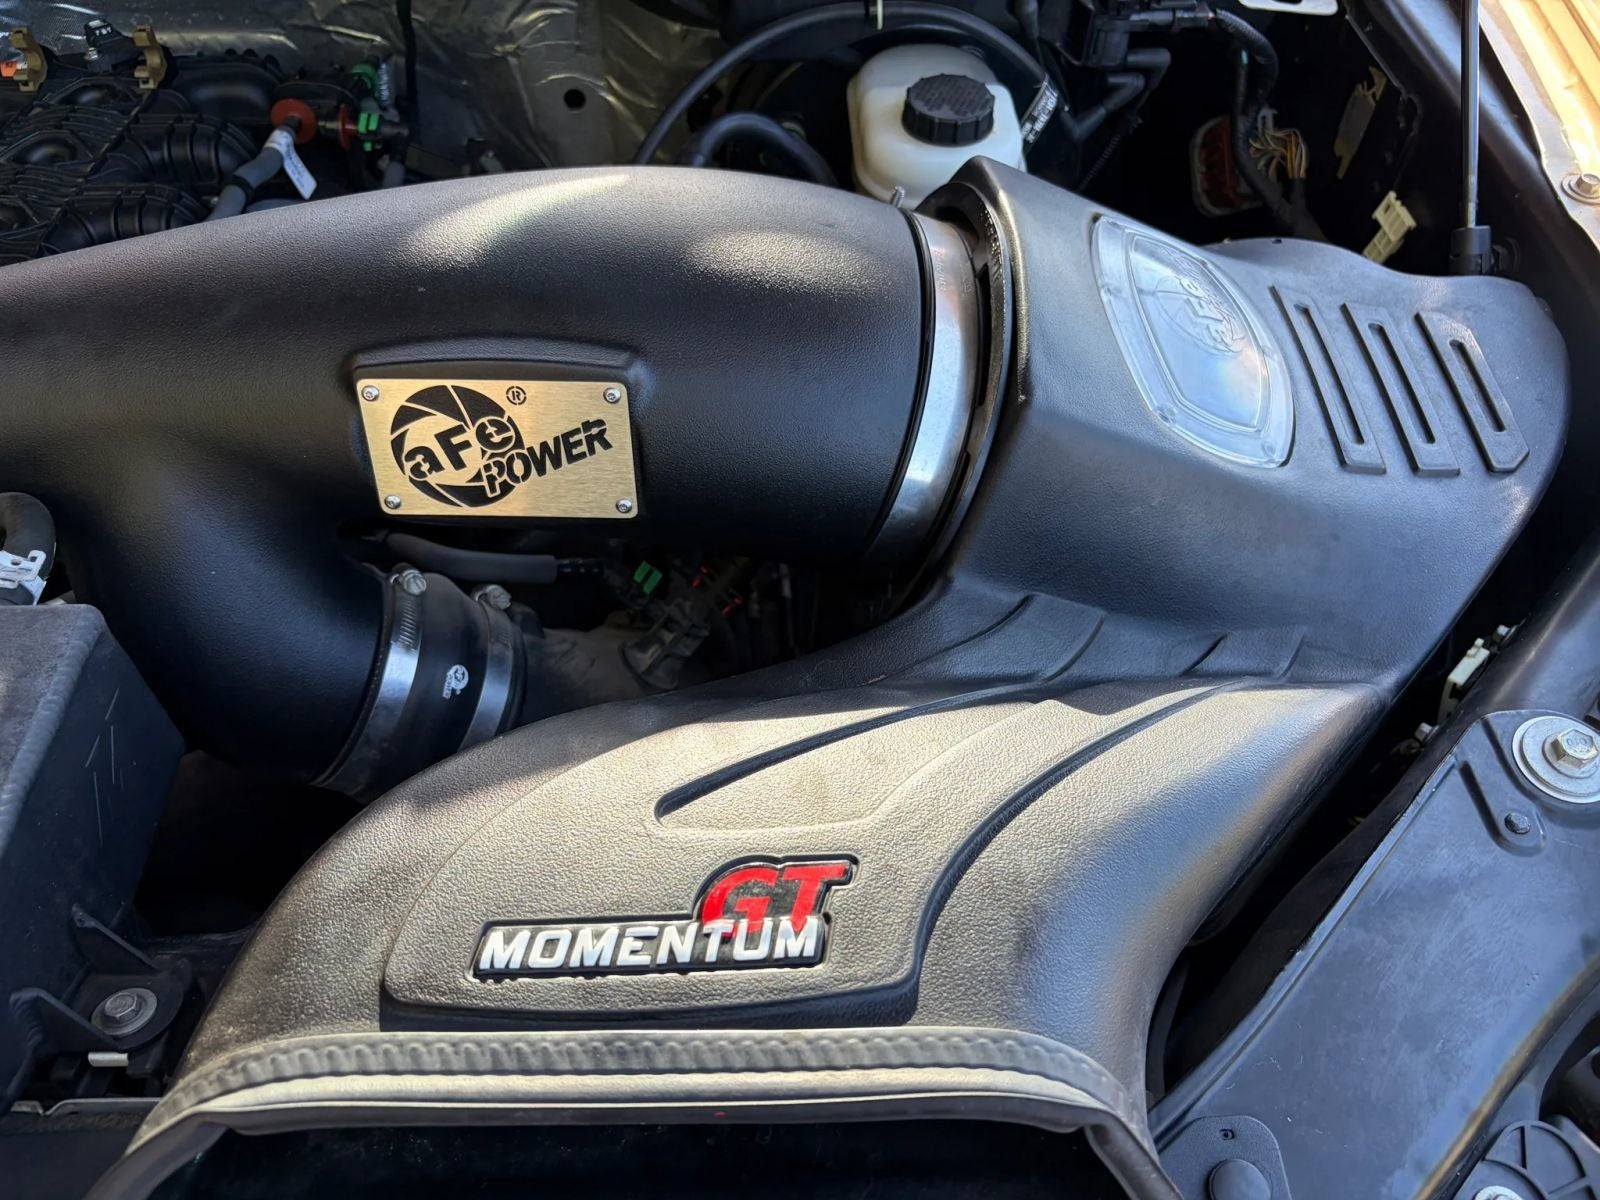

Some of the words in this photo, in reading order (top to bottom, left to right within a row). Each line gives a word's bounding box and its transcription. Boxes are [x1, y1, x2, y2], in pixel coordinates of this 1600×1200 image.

[404, 416, 515, 480] aFe
[482, 418, 614, 496] POWER
[702, 863, 848, 935] GT
[478, 915, 819, 970] MOMENTUM
